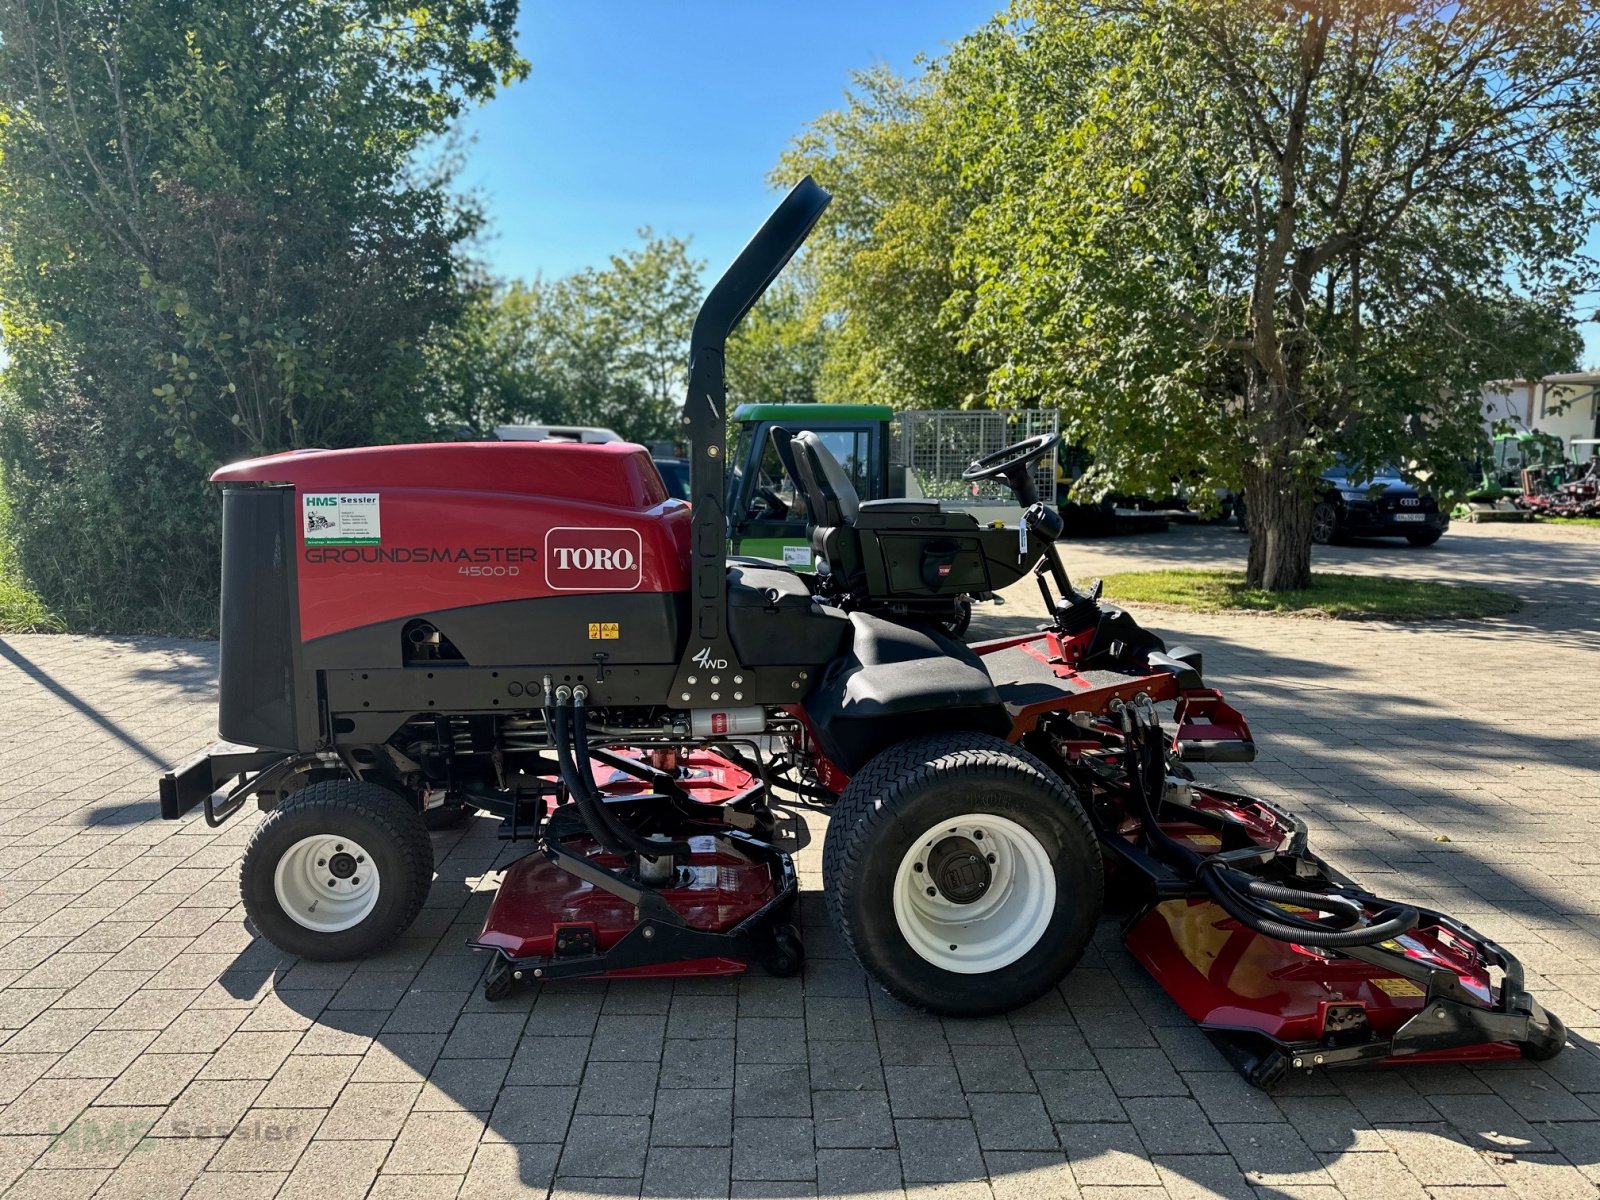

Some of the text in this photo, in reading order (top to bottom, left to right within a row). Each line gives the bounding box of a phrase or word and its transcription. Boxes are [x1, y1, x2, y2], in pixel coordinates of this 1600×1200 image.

[306, 496, 376, 506] HMS Sessler
[305, 547, 537, 563] GROUNDSMASTER
[691, 646, 728, 669] 4WD
